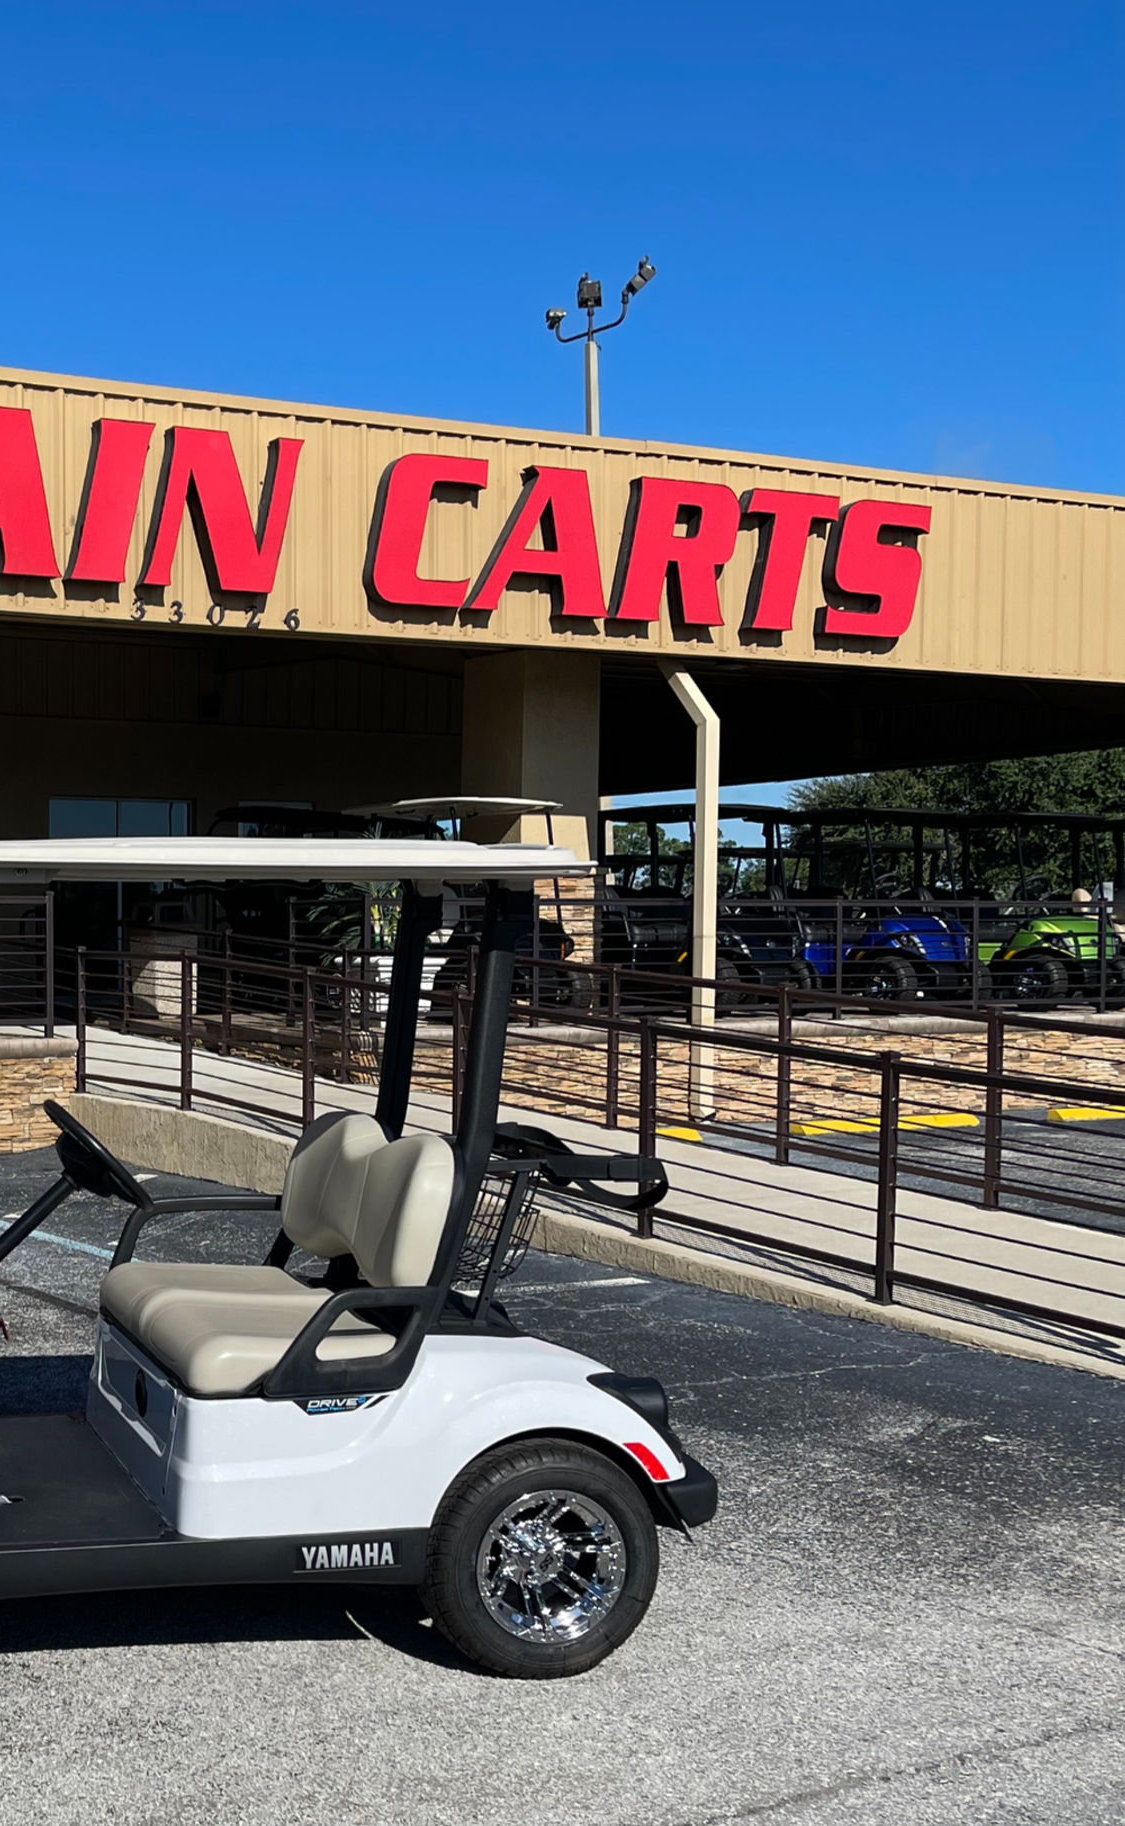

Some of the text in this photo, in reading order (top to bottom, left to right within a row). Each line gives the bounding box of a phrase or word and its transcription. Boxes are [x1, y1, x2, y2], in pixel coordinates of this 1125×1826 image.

[369, 452, 932, 639] CARTS
[130, 598, 301, 632] 33026
[301, 1541, 395, 1570] YAMAHA
